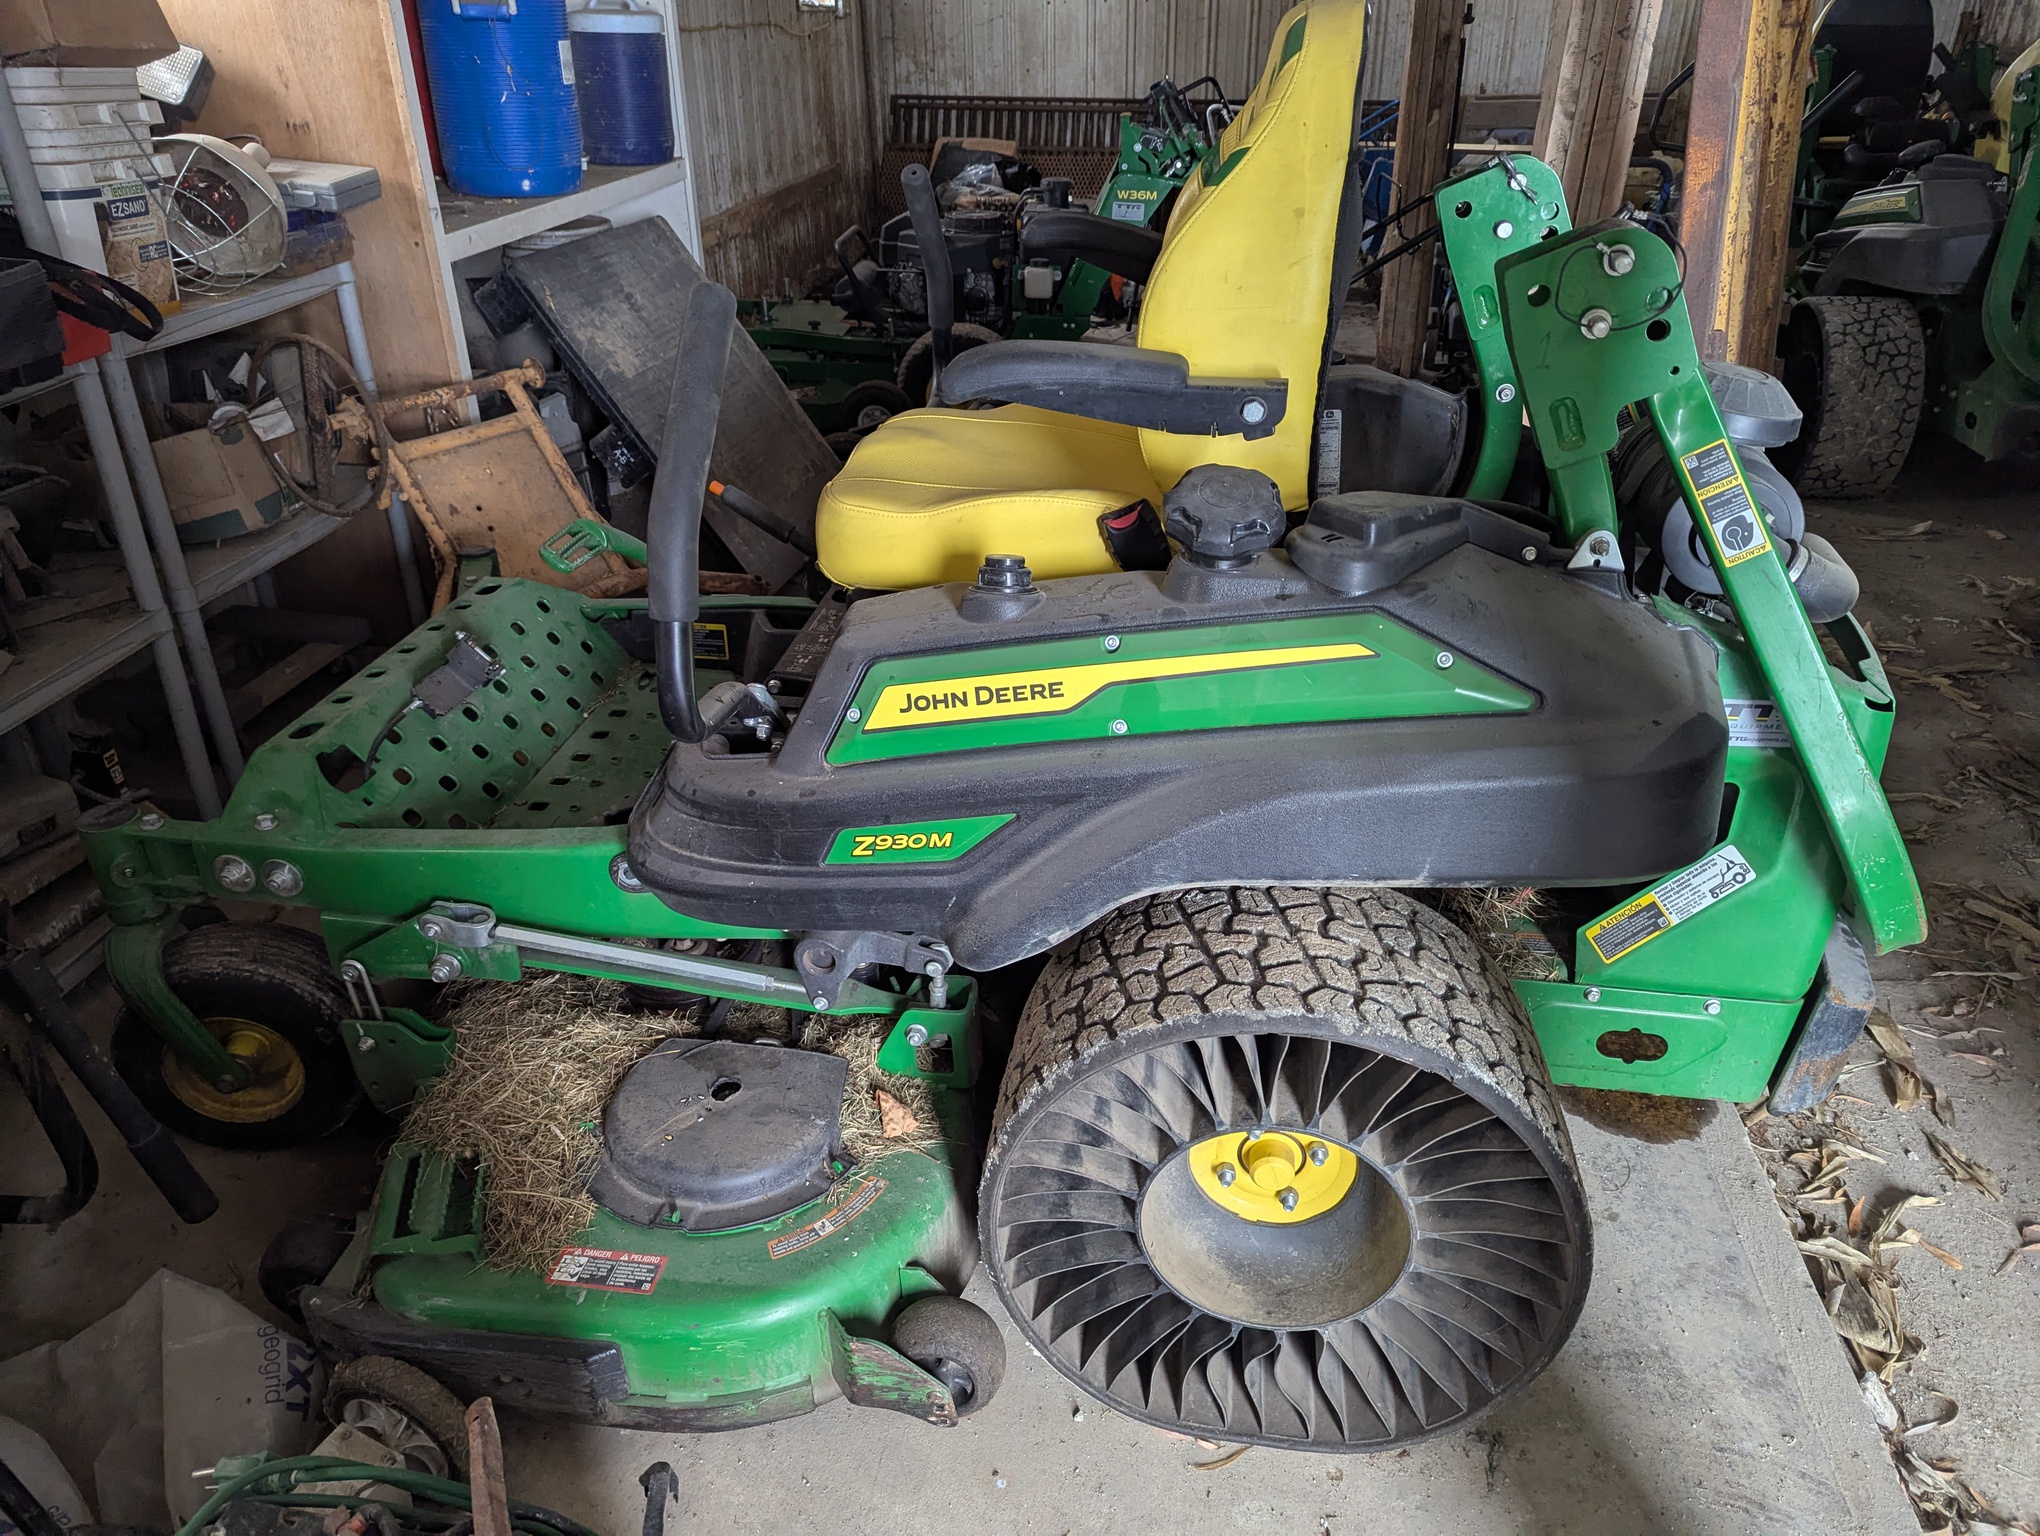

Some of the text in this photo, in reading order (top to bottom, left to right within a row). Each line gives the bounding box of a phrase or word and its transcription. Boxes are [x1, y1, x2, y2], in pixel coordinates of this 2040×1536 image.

[109, 182, 145, 198] Techniseal
[1117, 190, 1158, 200] W36M
[111, 201, 147, 217] EZSAND
[1697, 479, 1733, 498] ATENCIÓN
[1728, 546, 1761, 564] CAUTION
[900, 681, 1064, 713] JOHN DEERE
[1724, 704, 1780, 722] TT
[851, 832, 954, 858] Z930M
[1604, 900, 1642, 927] ATENCIÓN
[583, 1248, 612, 1258] DANGER
[629, 1253, 660, 1263] PELIGRO
[257, 1326, 286, 1404] geogrid
